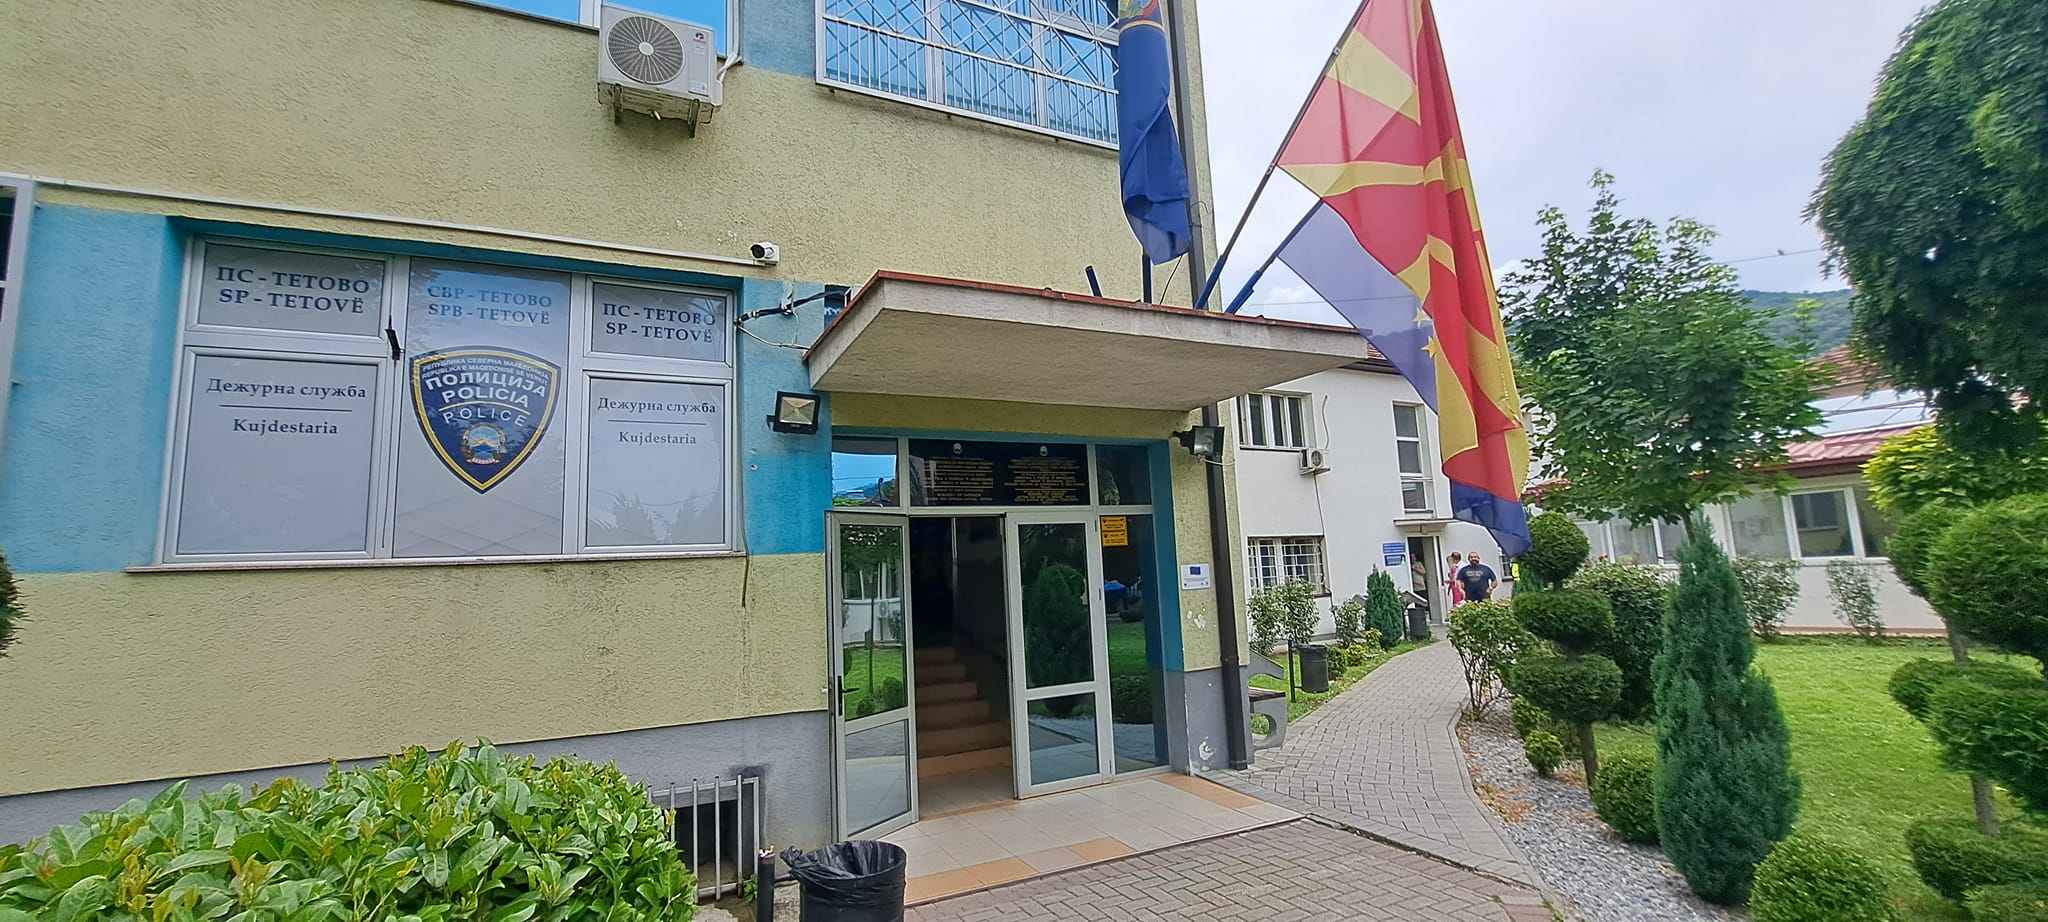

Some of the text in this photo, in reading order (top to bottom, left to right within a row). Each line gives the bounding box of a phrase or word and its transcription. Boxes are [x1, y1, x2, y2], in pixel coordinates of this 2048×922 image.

[216, 266, 254, 283] ПС
[271, 271, 370, 294] ТЕТОВО
[219, 288, 249, 304] SP
[267, 292, 364, 314] TETOVË
[427, 285, 464, 299] СВР
[478, 290, 552, 308] ТЕТОВО
[428, 303, 462, 317] SPB
[477, 307, 550, 325] TETOVË
[602, 303, 630, 317] ПС
[643, 307, 716, 326] ТЕТОВО
[606, 322, 628, 335] SP
[641, 325, 713, 343] TETOVË
[206, 377, 367, 400] Дежурна служба
[424, 372, 546, 398] ПОЛИЦИЈА
[441, 387, 529, 408] POLICIA
[598, 397, 716, 415] Дежурна служба
[233, 418, 338, 436] Kujdestaria
[443, 407, 528, 427] POLICE
[619, 431, 697, 446] Kujdestaria
